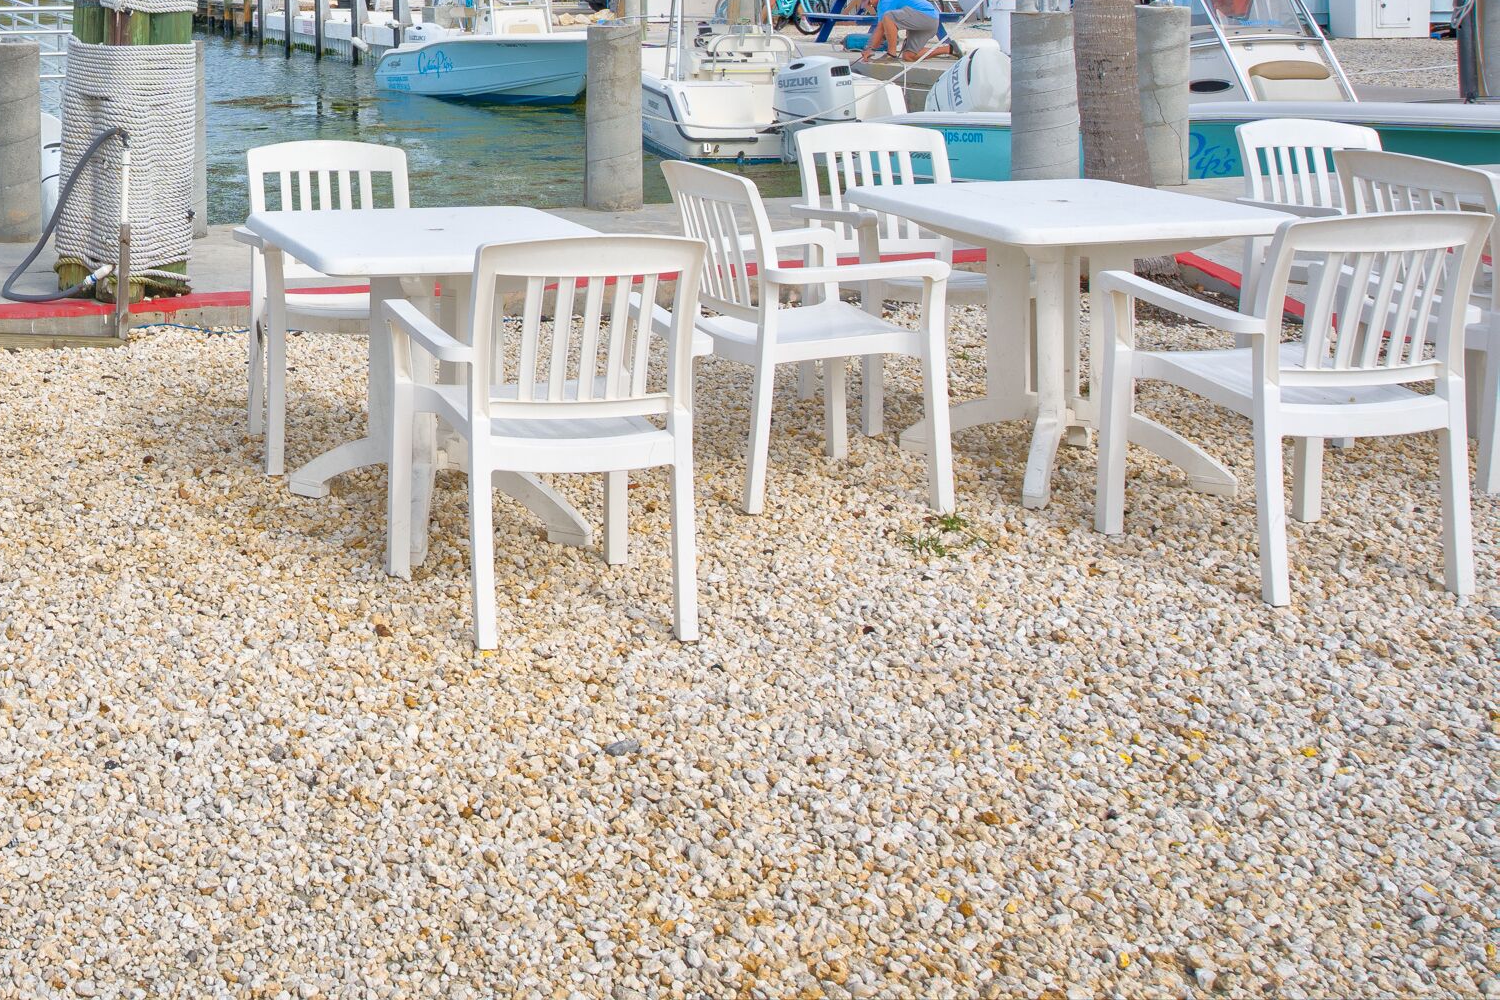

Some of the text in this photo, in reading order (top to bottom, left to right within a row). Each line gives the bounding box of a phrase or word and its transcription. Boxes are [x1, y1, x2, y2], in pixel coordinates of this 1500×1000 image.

[778, 76, 819, 89] SUZUKI
[952, 59, 963, 107] SUZUKI
[941, 128, 984, 144] ips.com
